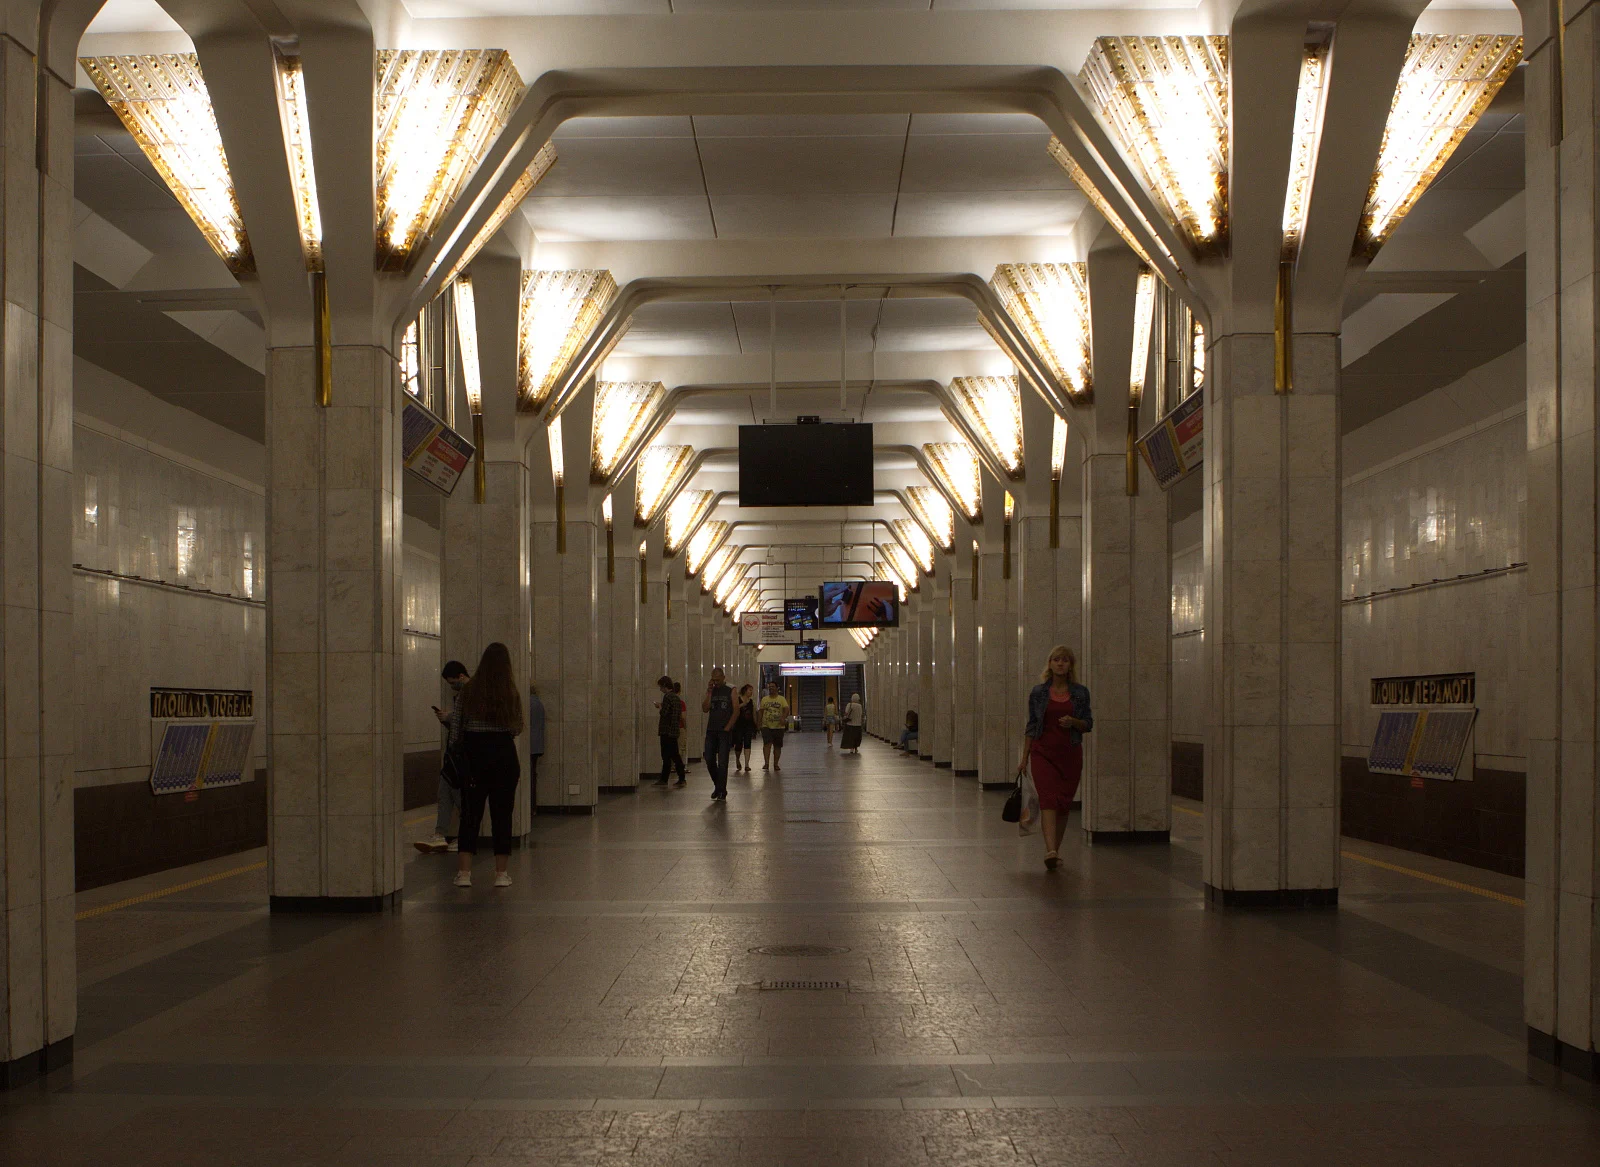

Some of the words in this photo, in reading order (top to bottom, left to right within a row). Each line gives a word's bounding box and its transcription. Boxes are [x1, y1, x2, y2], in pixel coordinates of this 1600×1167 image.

[1372, 682, 1412, 704] ПЛОШЧА
[1415, 679, 1472, 704] ПЕРАМОГІ
[154, 692, 209, 717] ПЛОЩАДЬ
